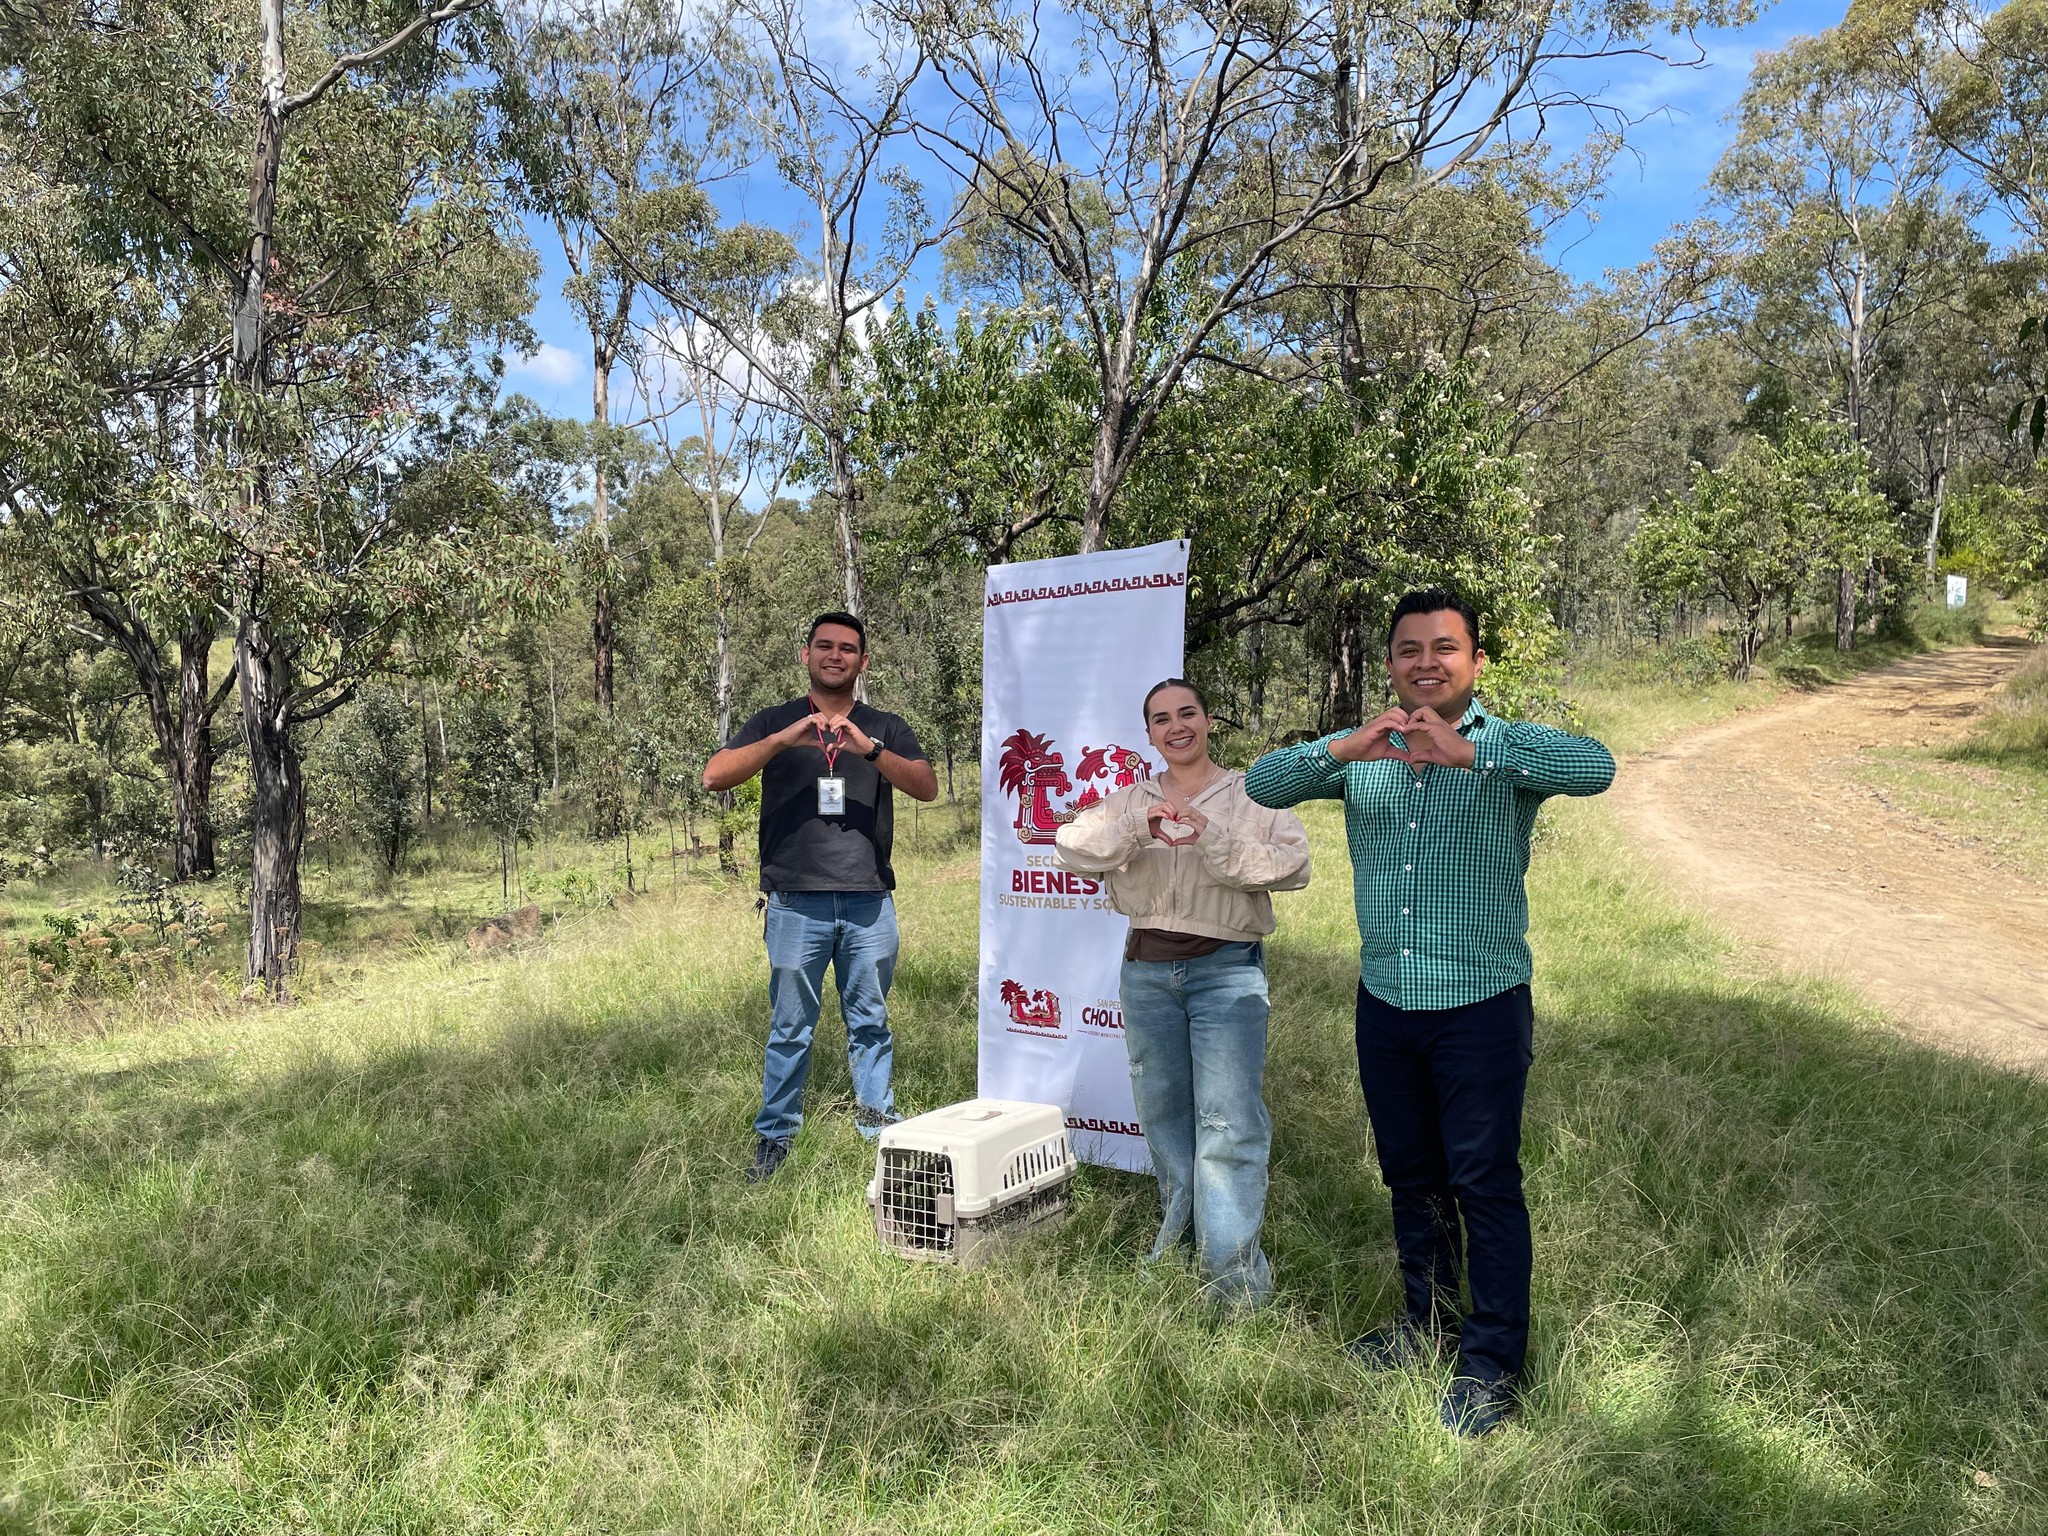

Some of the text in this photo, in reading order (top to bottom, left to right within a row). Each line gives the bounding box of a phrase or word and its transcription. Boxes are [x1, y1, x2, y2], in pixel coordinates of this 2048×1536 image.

[999, 893, 1076, 910] SUSTENTABLE
[1080, 898, 1089, 910] Y
[1097, 998, 1108, 1009] SAN
